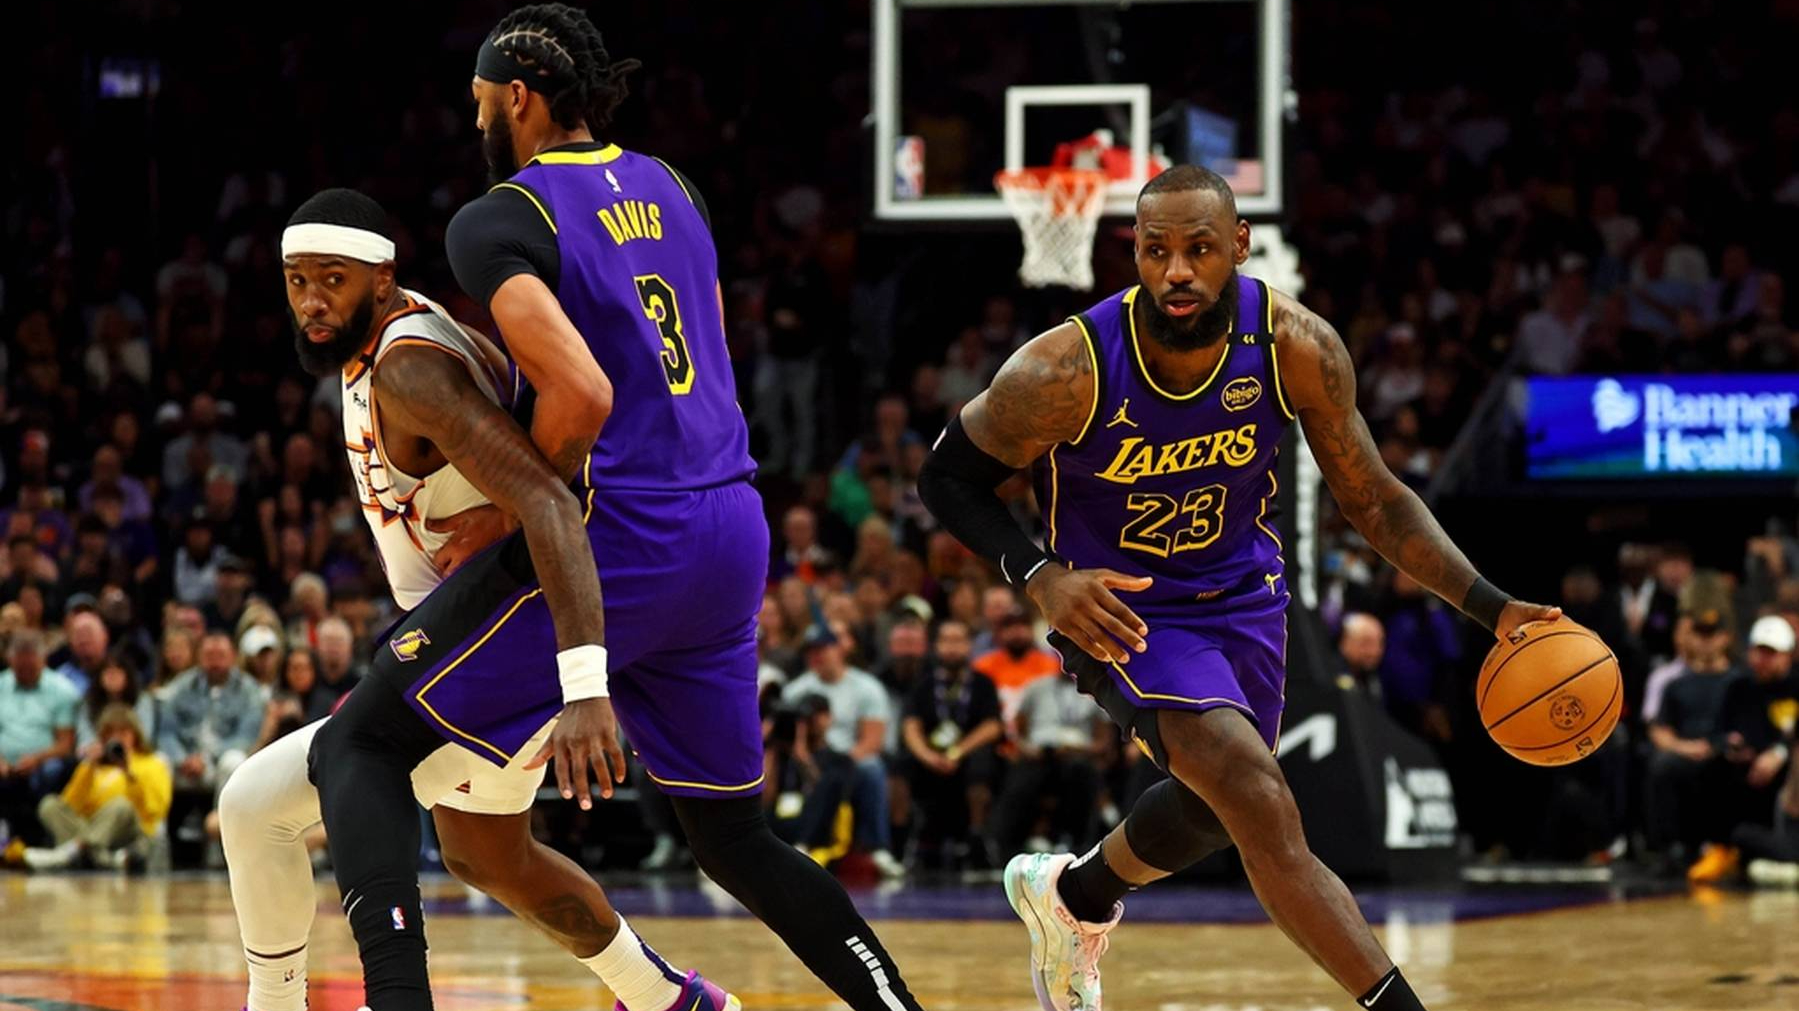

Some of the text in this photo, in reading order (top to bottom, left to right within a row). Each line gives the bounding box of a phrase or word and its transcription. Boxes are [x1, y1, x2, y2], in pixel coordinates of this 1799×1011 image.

[597, 200, 662, 245] DAVIS
[633, 273, 695, 395] 3
[1644, 383, 1797, 429] Banner
[1094, 424, 1257, 484] LAKERS
[1644, 428, 1782, 470] Health
[1119, 483, 1227, 559] 23
